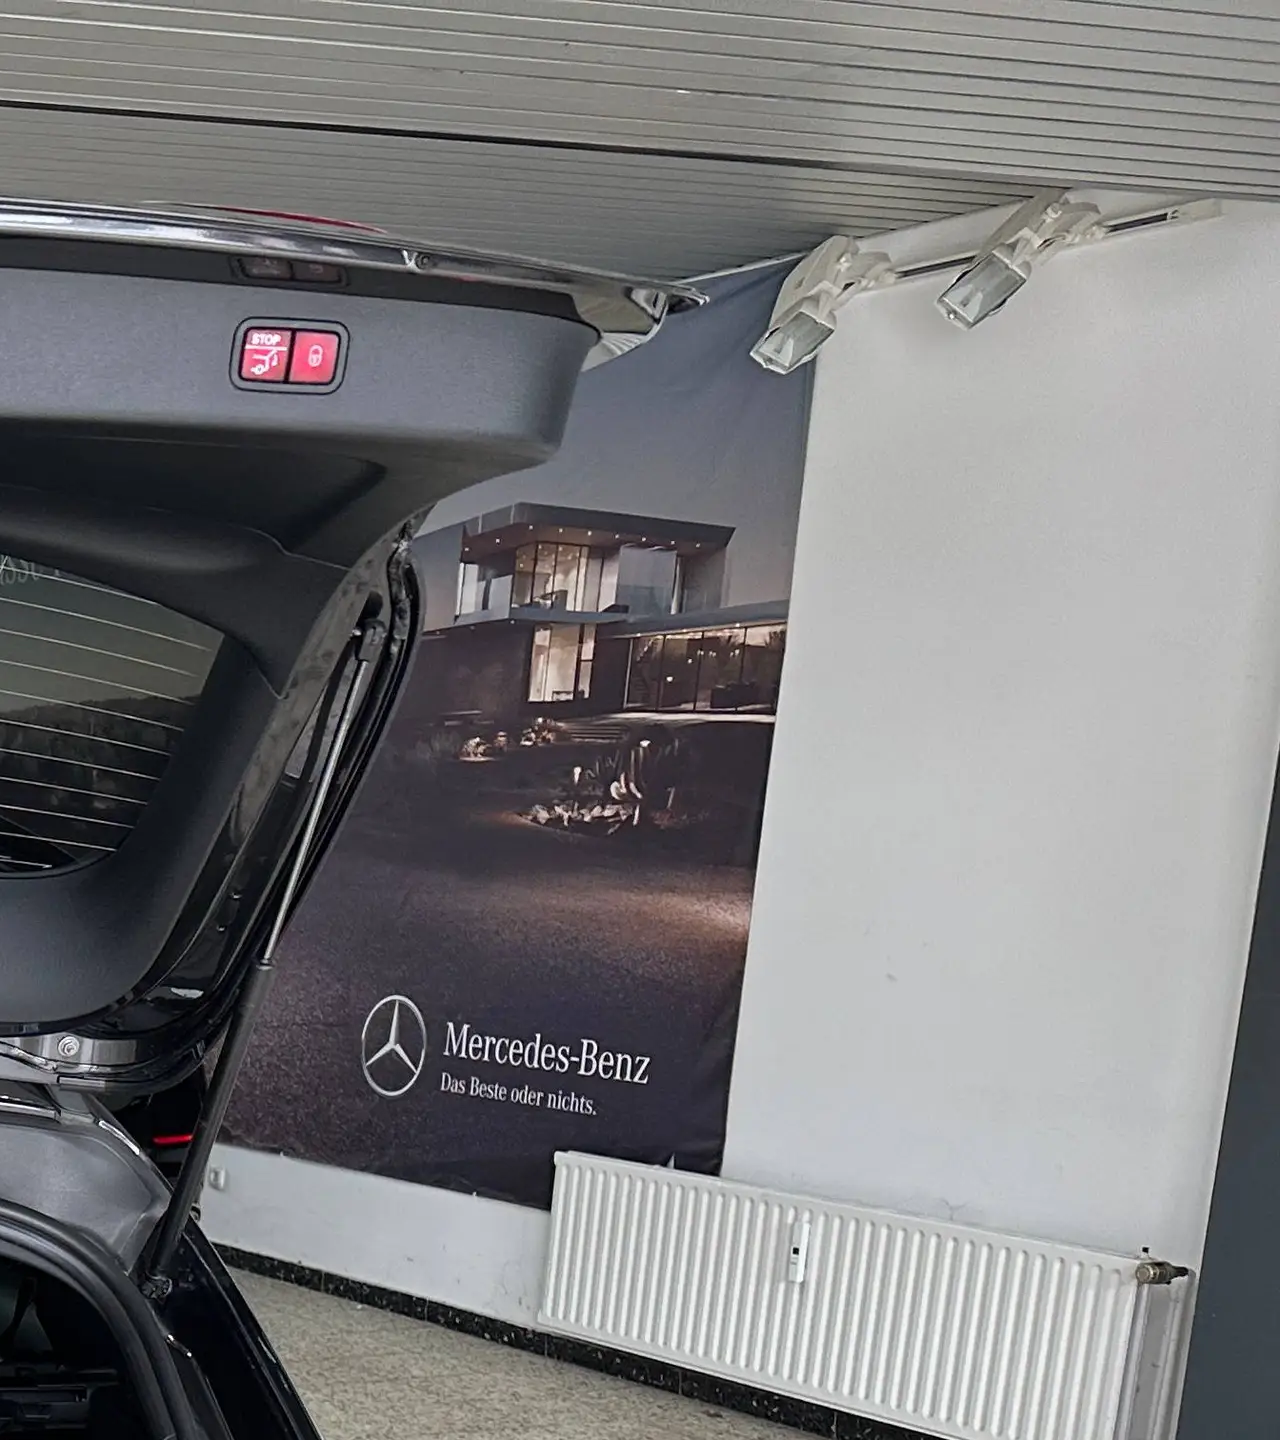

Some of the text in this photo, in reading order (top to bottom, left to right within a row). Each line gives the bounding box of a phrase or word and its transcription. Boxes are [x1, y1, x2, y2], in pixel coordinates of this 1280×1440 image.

[252, 333, 281, 345] STOP
[443, 1021, 651, 1085] Mercedes-Benz
[440, 1072, 597, 1116] Das Beste oder nichts.
